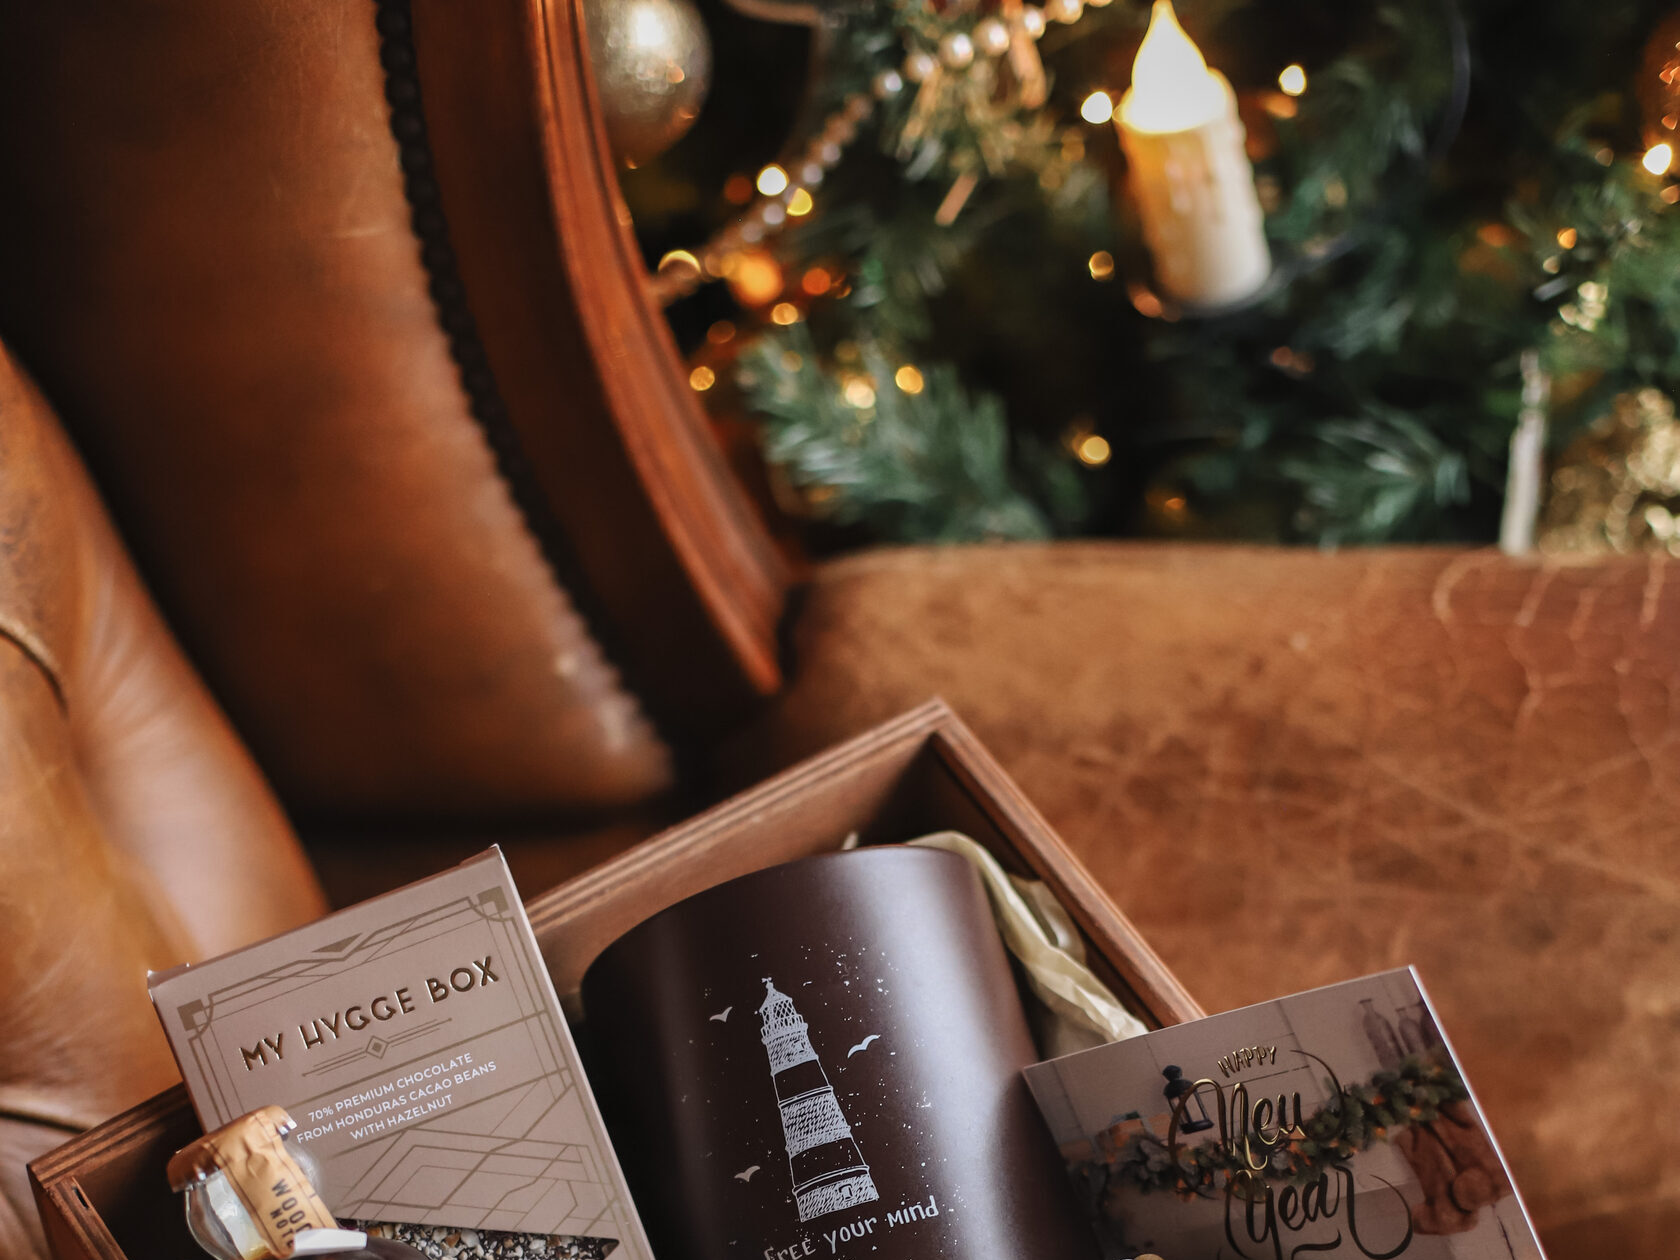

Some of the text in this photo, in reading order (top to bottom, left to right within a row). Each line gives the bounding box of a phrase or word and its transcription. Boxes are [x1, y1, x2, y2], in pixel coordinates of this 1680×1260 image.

[239, 955, 499, 1071] MY HYGGE BOX
[308, 1052, 473, 1123] 70% PREMIUM CHOCOLATE
[1217, 1046, 1277, 1078] HAPPY
[296, 1061, 497, 1144] FROM HONDURAS CACAO BEANS
[350, 1094, 453, 1140] WITH HAZELNUT
